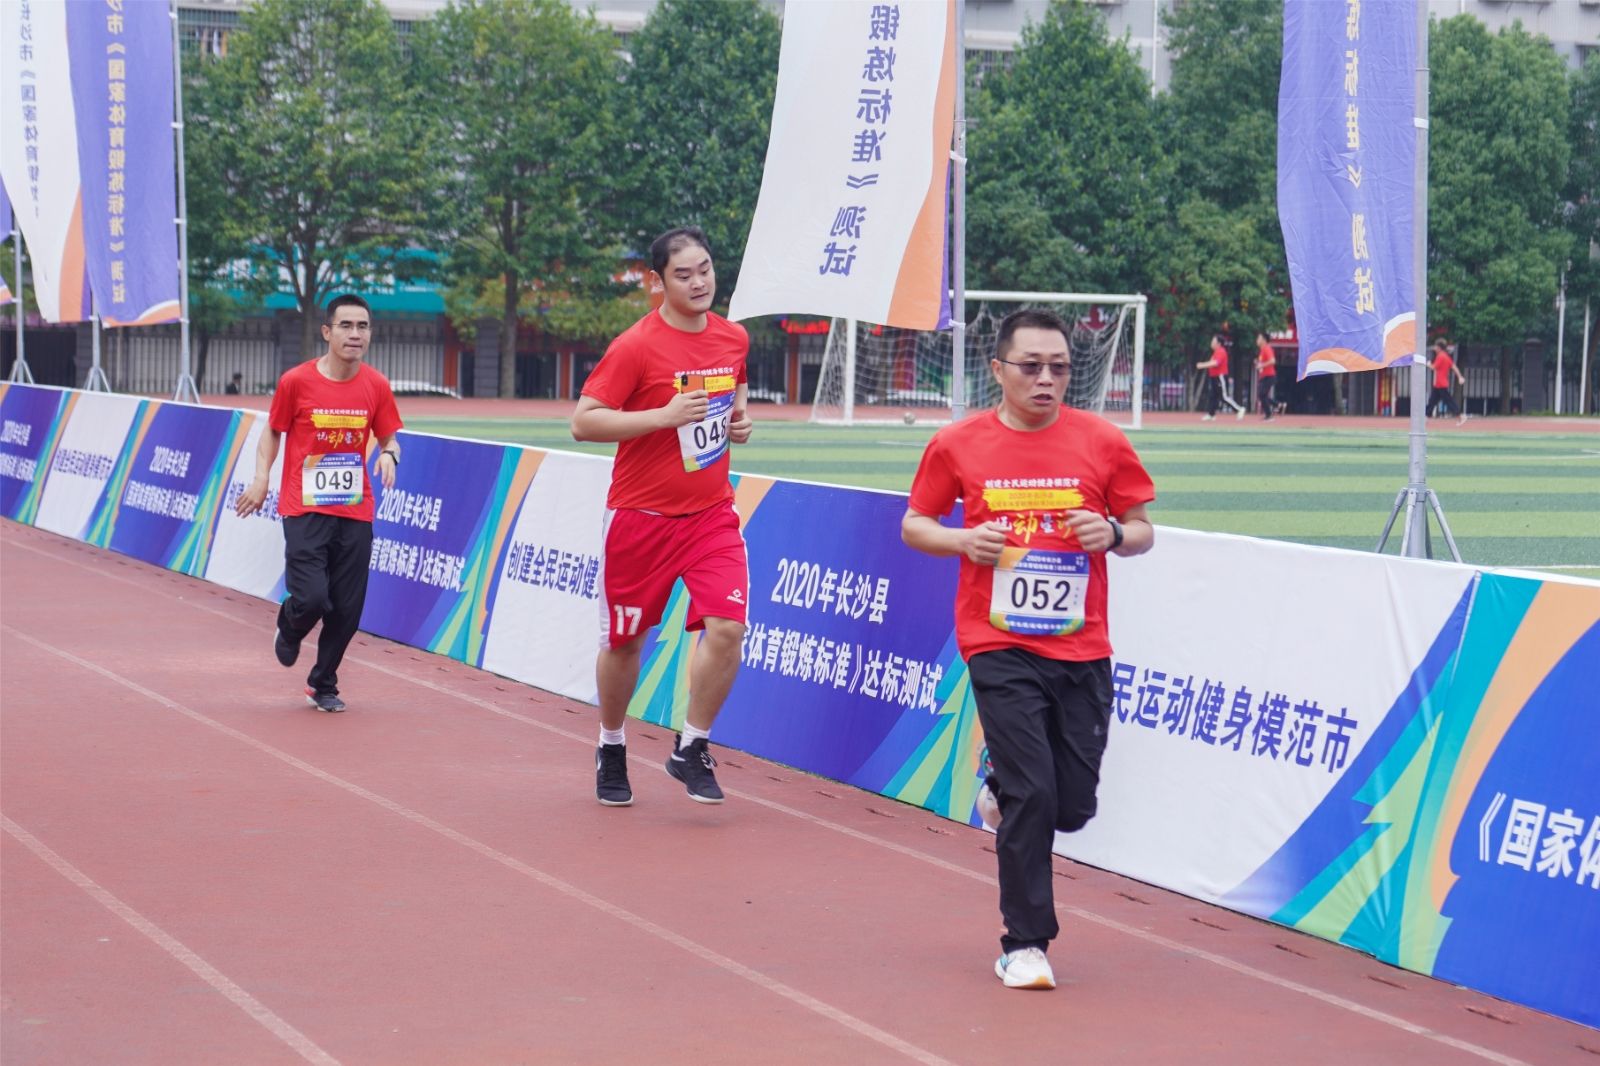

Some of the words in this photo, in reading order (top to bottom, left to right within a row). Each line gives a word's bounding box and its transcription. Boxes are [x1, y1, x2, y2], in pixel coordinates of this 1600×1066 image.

[315, 470, 354, 490] 049
[376, 489, 443, 532] 2020年长沙县
[507, 540, 599, 600] 创建全民运动健
[771, 557, 891, 625] 2020年长沙县
[1011, 577, 1071, 611] 052
[614, 604, 643, 636] 17
[1110, 661, 1359, 774] 民运动健身模范市
